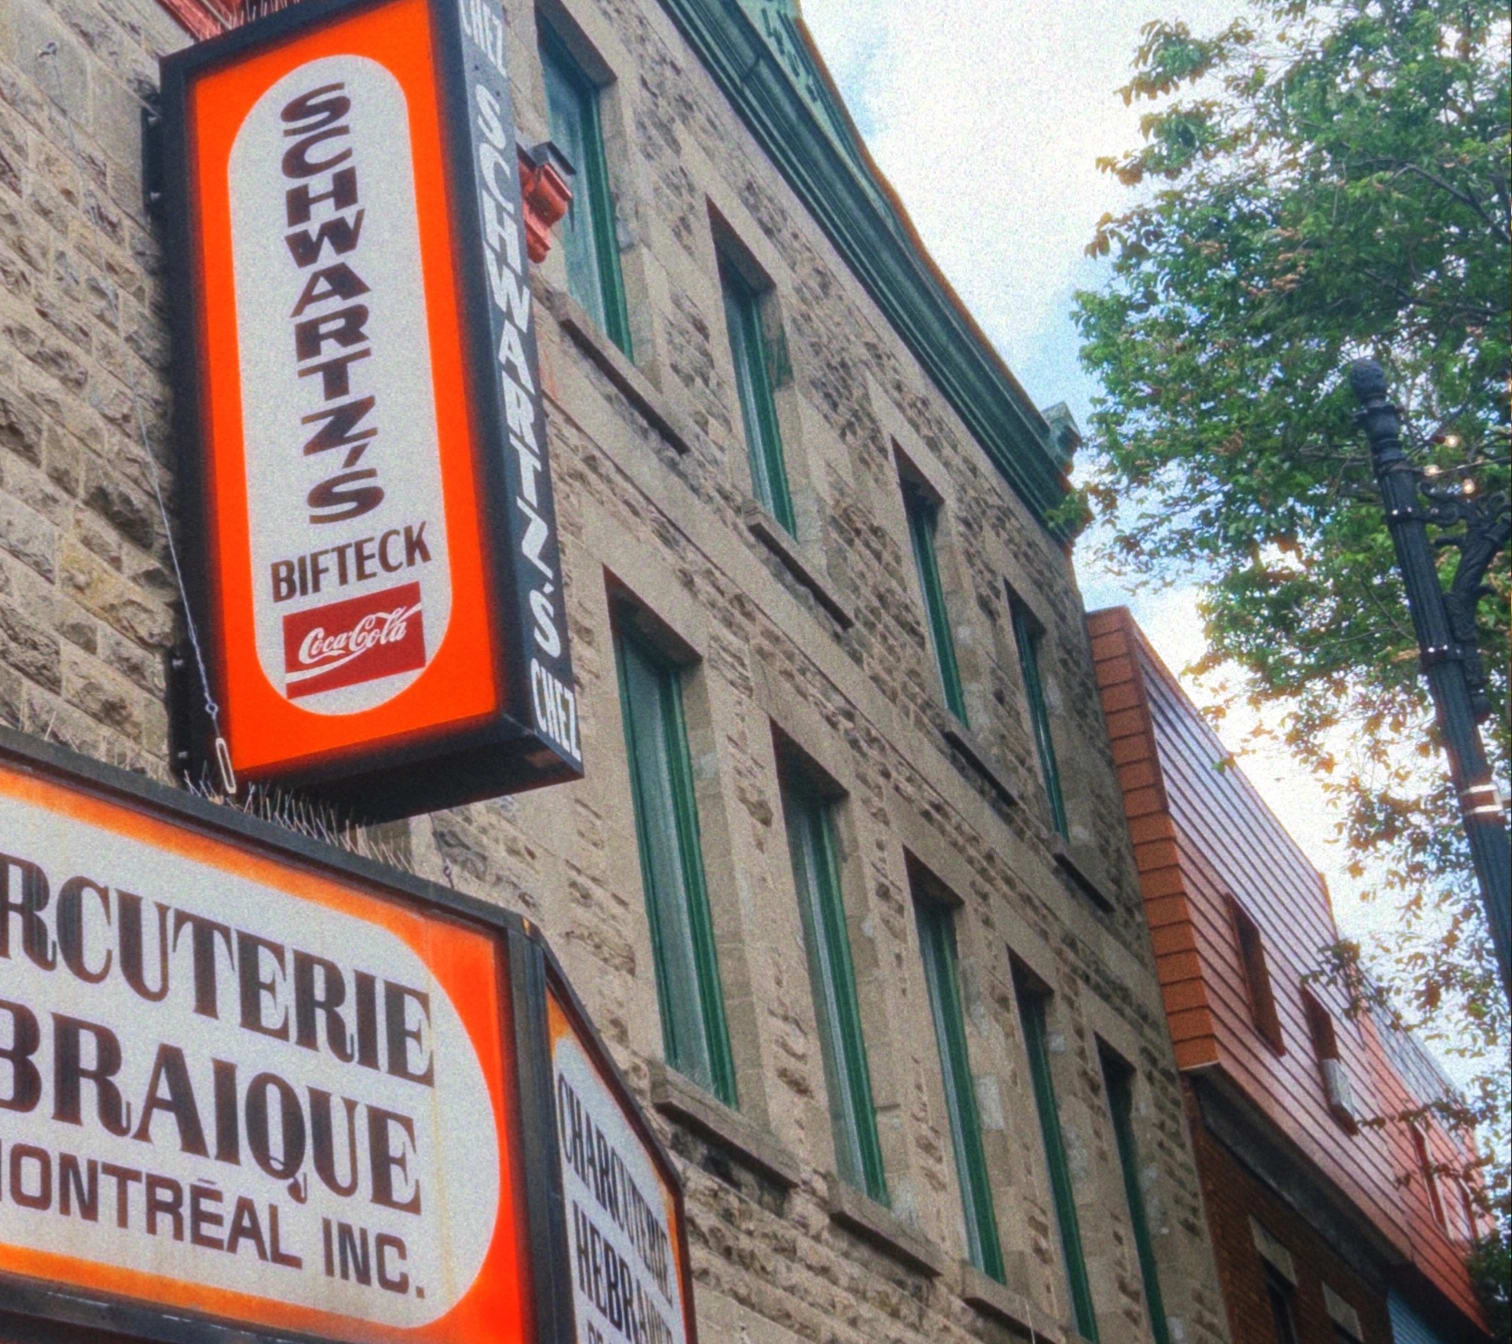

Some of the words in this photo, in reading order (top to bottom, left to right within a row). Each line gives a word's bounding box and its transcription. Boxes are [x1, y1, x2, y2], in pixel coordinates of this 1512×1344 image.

[280, 81, 385, 525] SCHWARTZ'S
[474, 83, 561, 659] SCHWARTZ'S
[271, 521, 432, 604] BIFTECK
[531, 657, 582, 763] CHEZ
[324, 1216, 428, 1301] INC.
